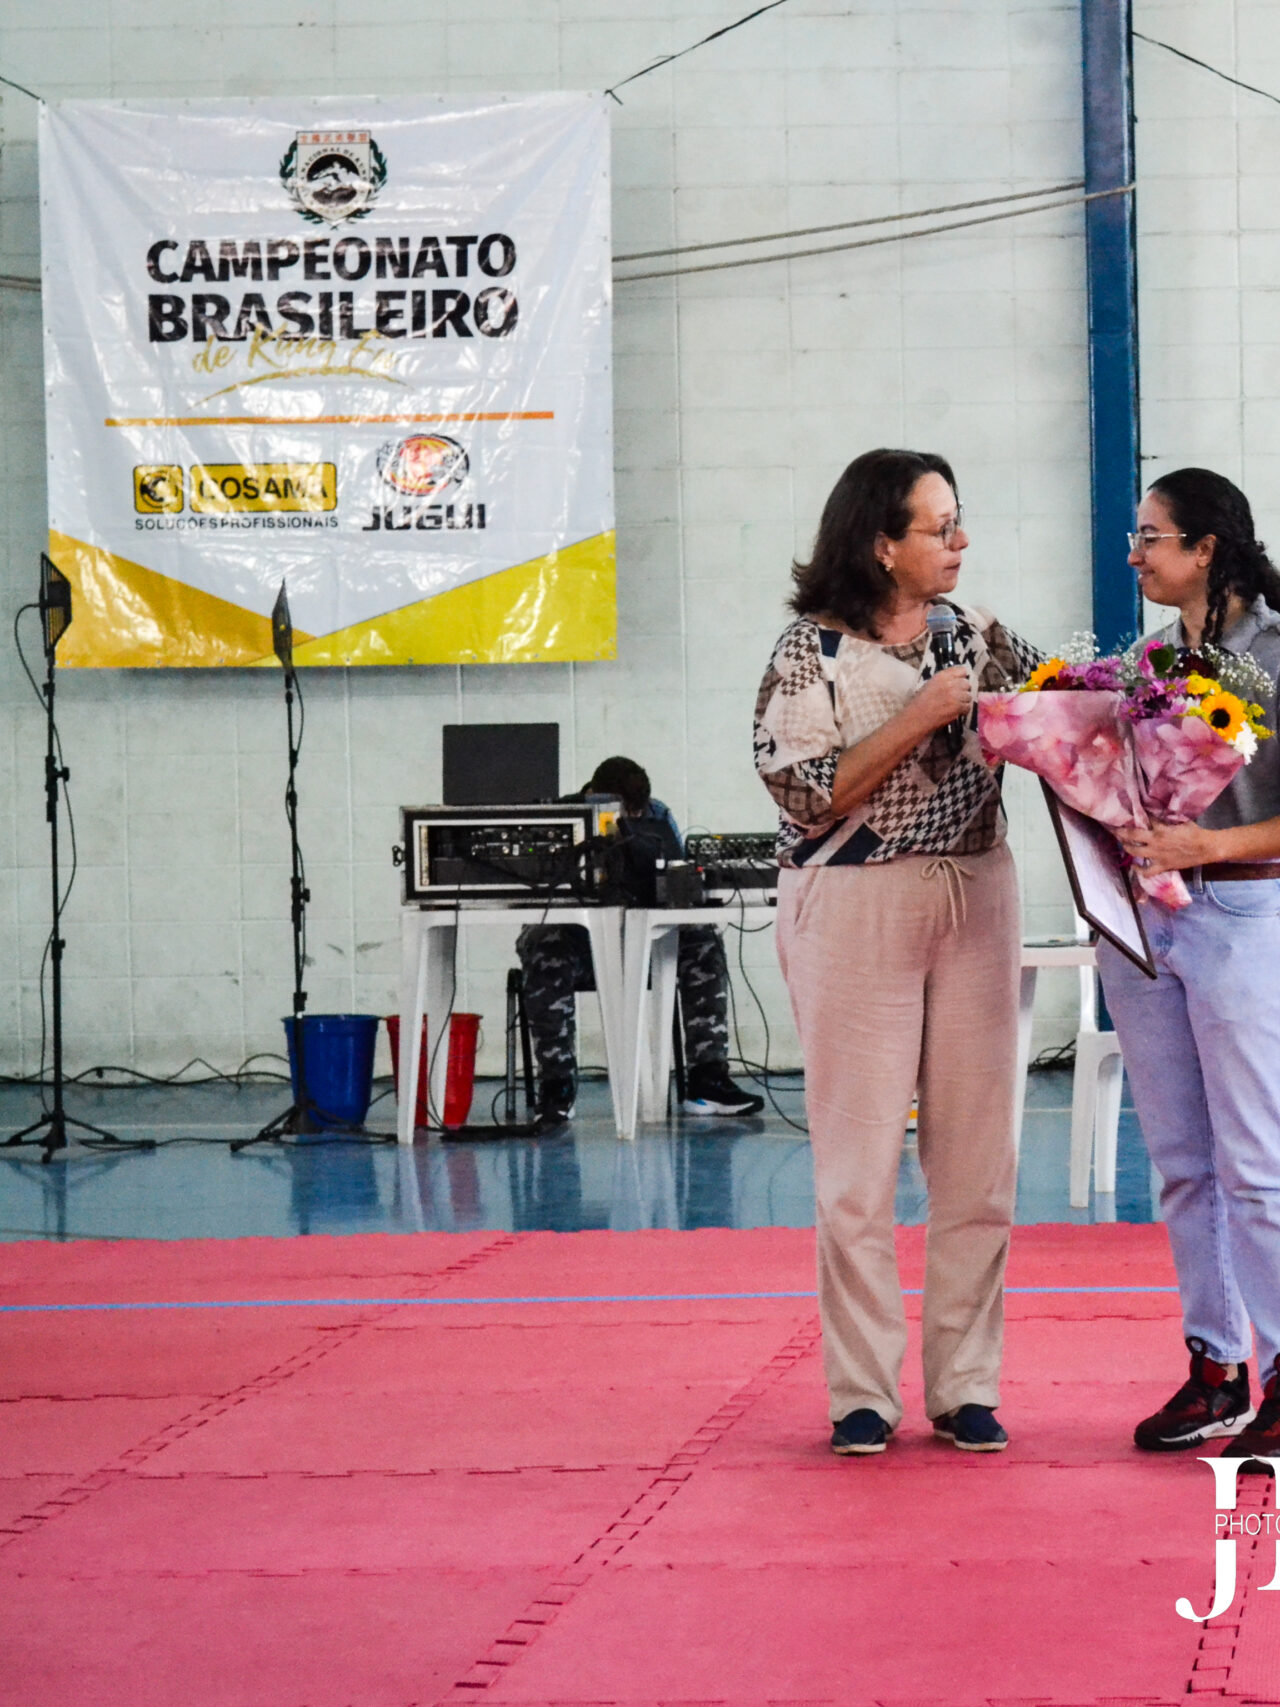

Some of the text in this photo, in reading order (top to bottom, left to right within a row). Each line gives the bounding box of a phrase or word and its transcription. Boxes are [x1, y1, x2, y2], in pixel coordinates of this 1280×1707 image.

[146, 233, 517, 283] CAMPEONATO
[148, 286, 519, 342] BRASILEIRO
[191, 333, 236, 374] de
[246, 321, 337, 370] Kung
[220, 515, 340, 529] PROFISSIONAIS
[361, 503, 486, 531] JUGUI
